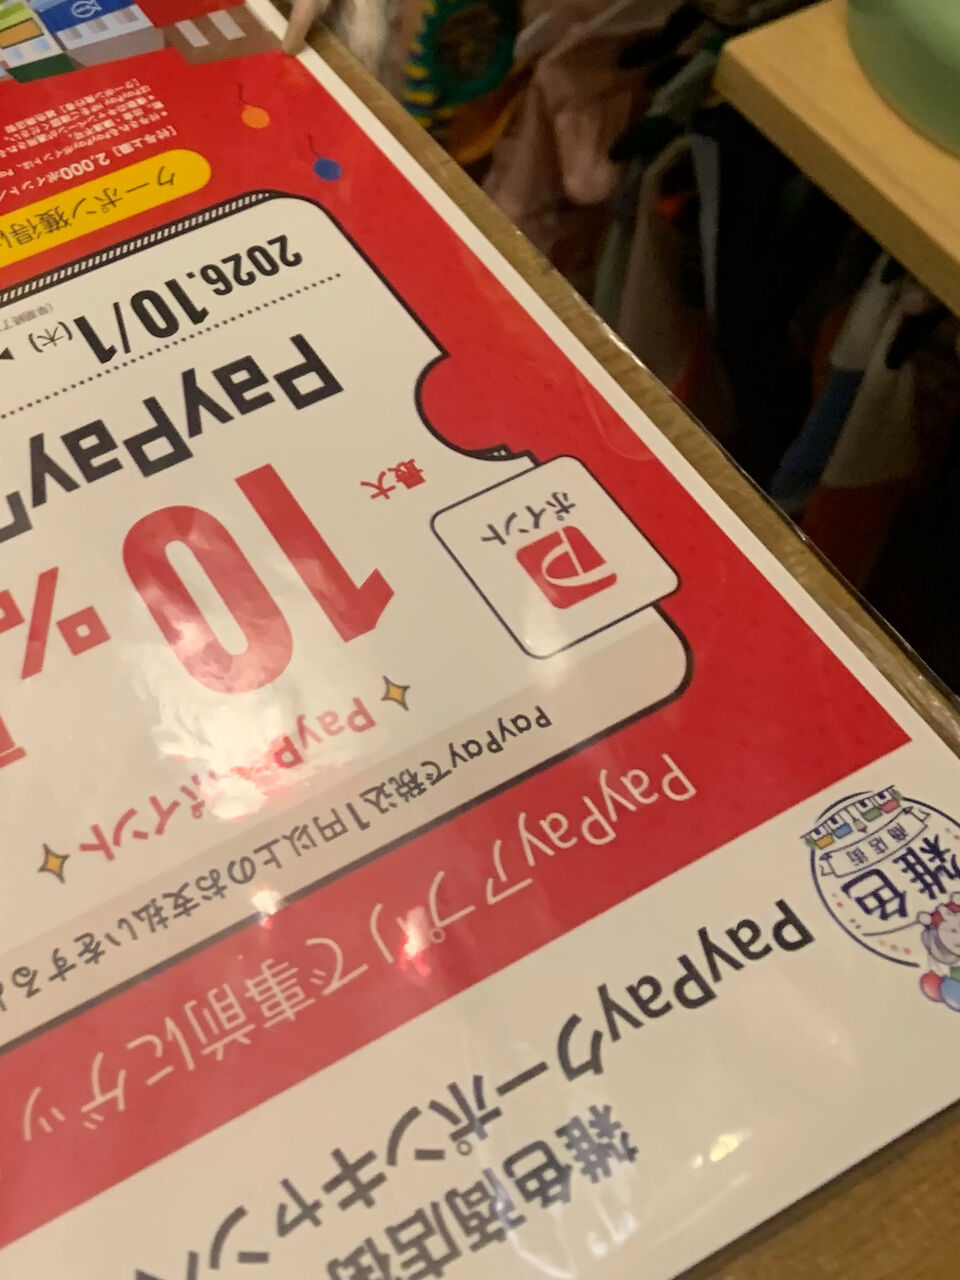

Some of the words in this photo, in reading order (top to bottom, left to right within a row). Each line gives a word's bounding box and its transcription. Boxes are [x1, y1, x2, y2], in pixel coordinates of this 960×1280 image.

[362, 460, 424, 498] 最大
[482, 492, 575, 545] ポイント
[80, 699, 375, 860] PayPポイント
[842, 823, 915, 863] 商店街
[842, 836, 960, 920] 雑色
